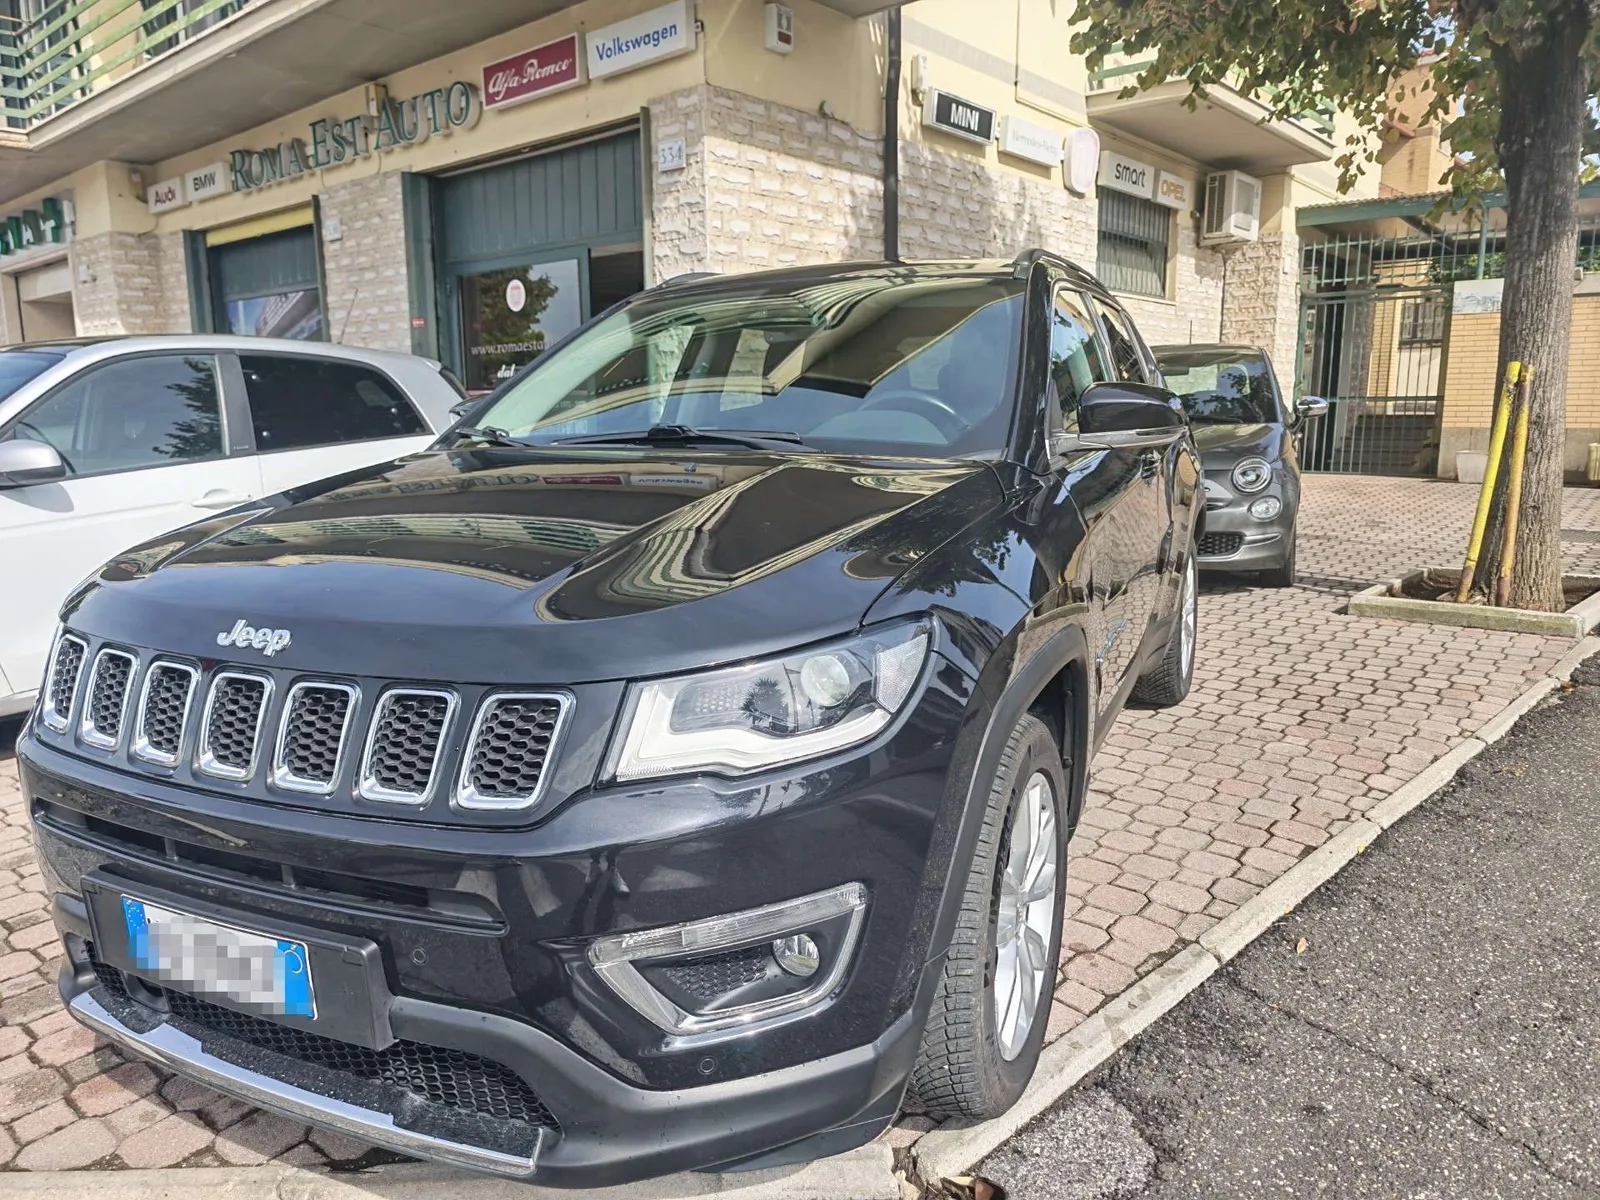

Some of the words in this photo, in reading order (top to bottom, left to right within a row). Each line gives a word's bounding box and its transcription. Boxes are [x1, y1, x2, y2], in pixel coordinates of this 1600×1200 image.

[596, 23, 677, 61] Volkswagen
[488, 67, 519, 101] Alfa
[522, 58, 570, 85] Romeo
[950, 103, 979, 132] MINI
[229, 138, 308, 192] ROMA
[309, 117, 364, 169] EST
[375, 81, 474, 151] AUTO
[193, 171, 216, 192] BMW
[1115, 163, 1146, 188] smart
[155, 186, 176, 206] Audi
[1161, 179, 1186, 202] OPEL
[216, 619, 292, 658] Jeep
